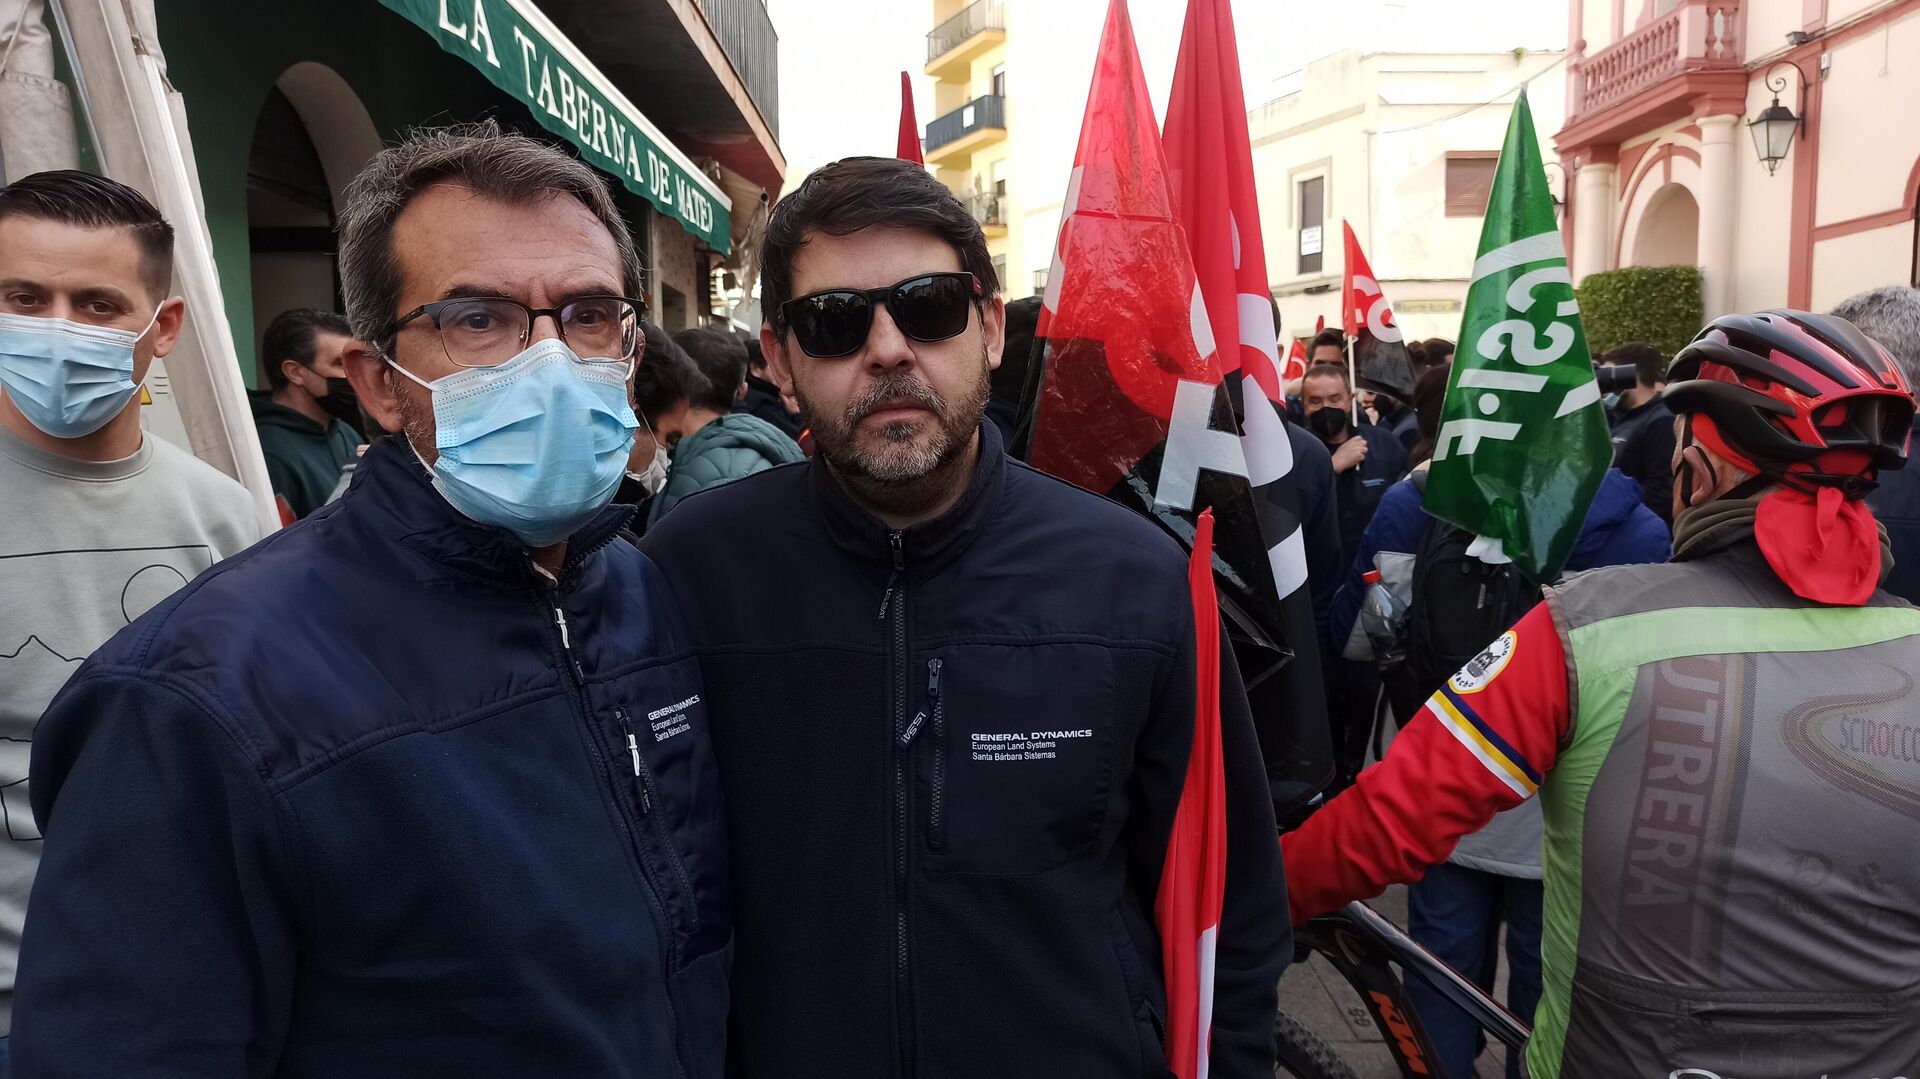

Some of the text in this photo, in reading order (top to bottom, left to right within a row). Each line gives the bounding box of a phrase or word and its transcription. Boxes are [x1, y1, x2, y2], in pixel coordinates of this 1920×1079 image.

[438, 0, 501, 68] LA
[513, 26, 644, 184] TABERNA
[647, 149, 673, 206] DE
[971, 729, 1092, 741] GENERAL DYNAMICS
[972, 740, 1056, 752] European Land Systems
[972, 751, 1056, 761] Santa Bárbara Sistemas
[1625, 655, 1721, 906] UTRERA
[1369, 990, 1429, 1075] KTM
